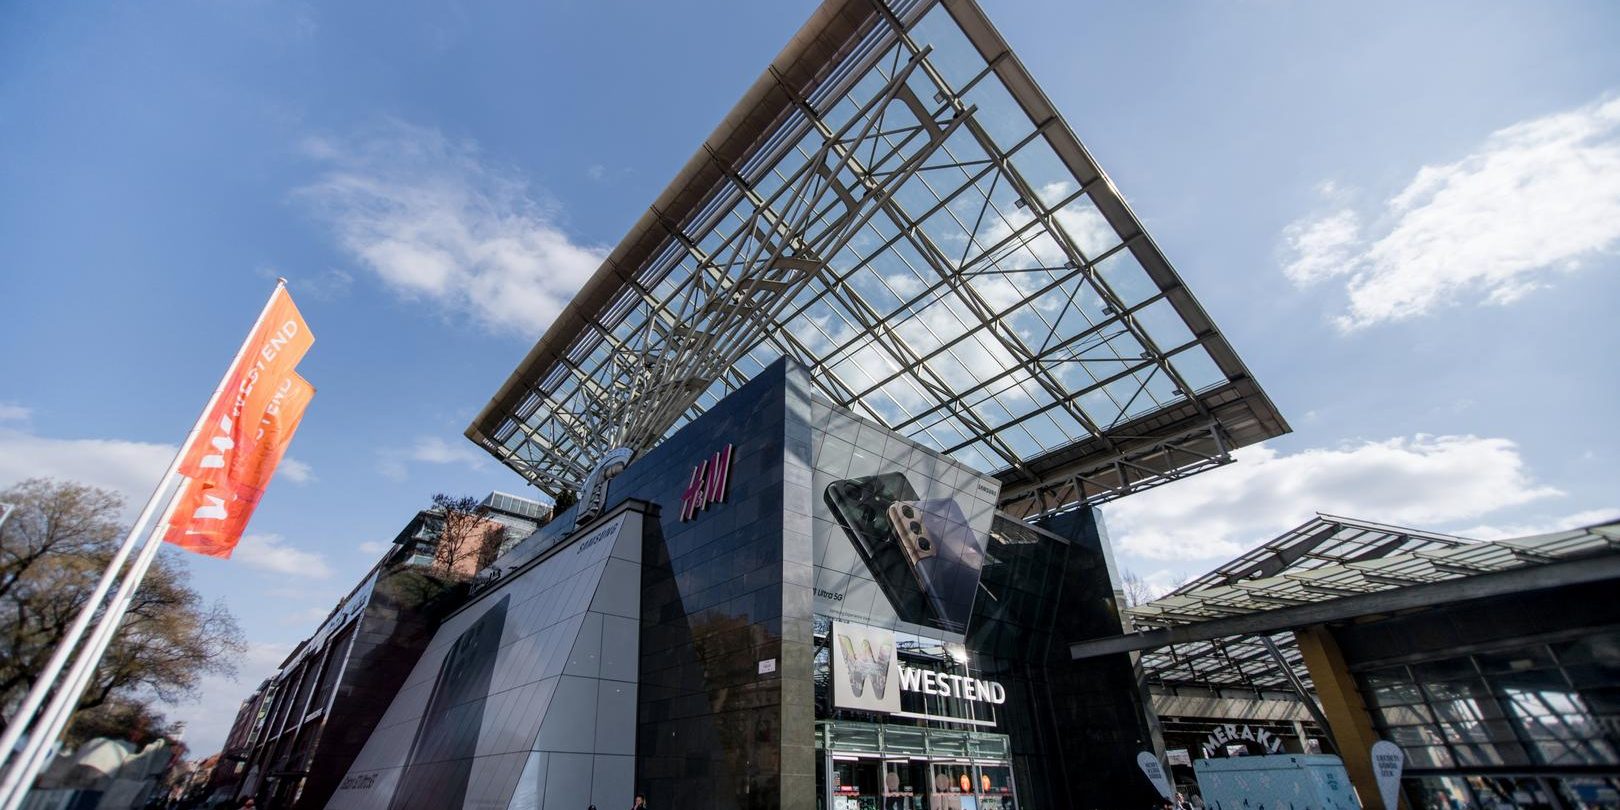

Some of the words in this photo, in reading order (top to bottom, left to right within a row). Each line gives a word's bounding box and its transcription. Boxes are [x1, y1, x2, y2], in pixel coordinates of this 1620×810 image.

[680, 443, 732, 522] H&M
[817, 589, 833, 600] Ultra
[833, 592, 843, 601] 5G
[897, 665, 1006, 704] WESTEND
[1202, 724, 1281, 757] MERAKI
